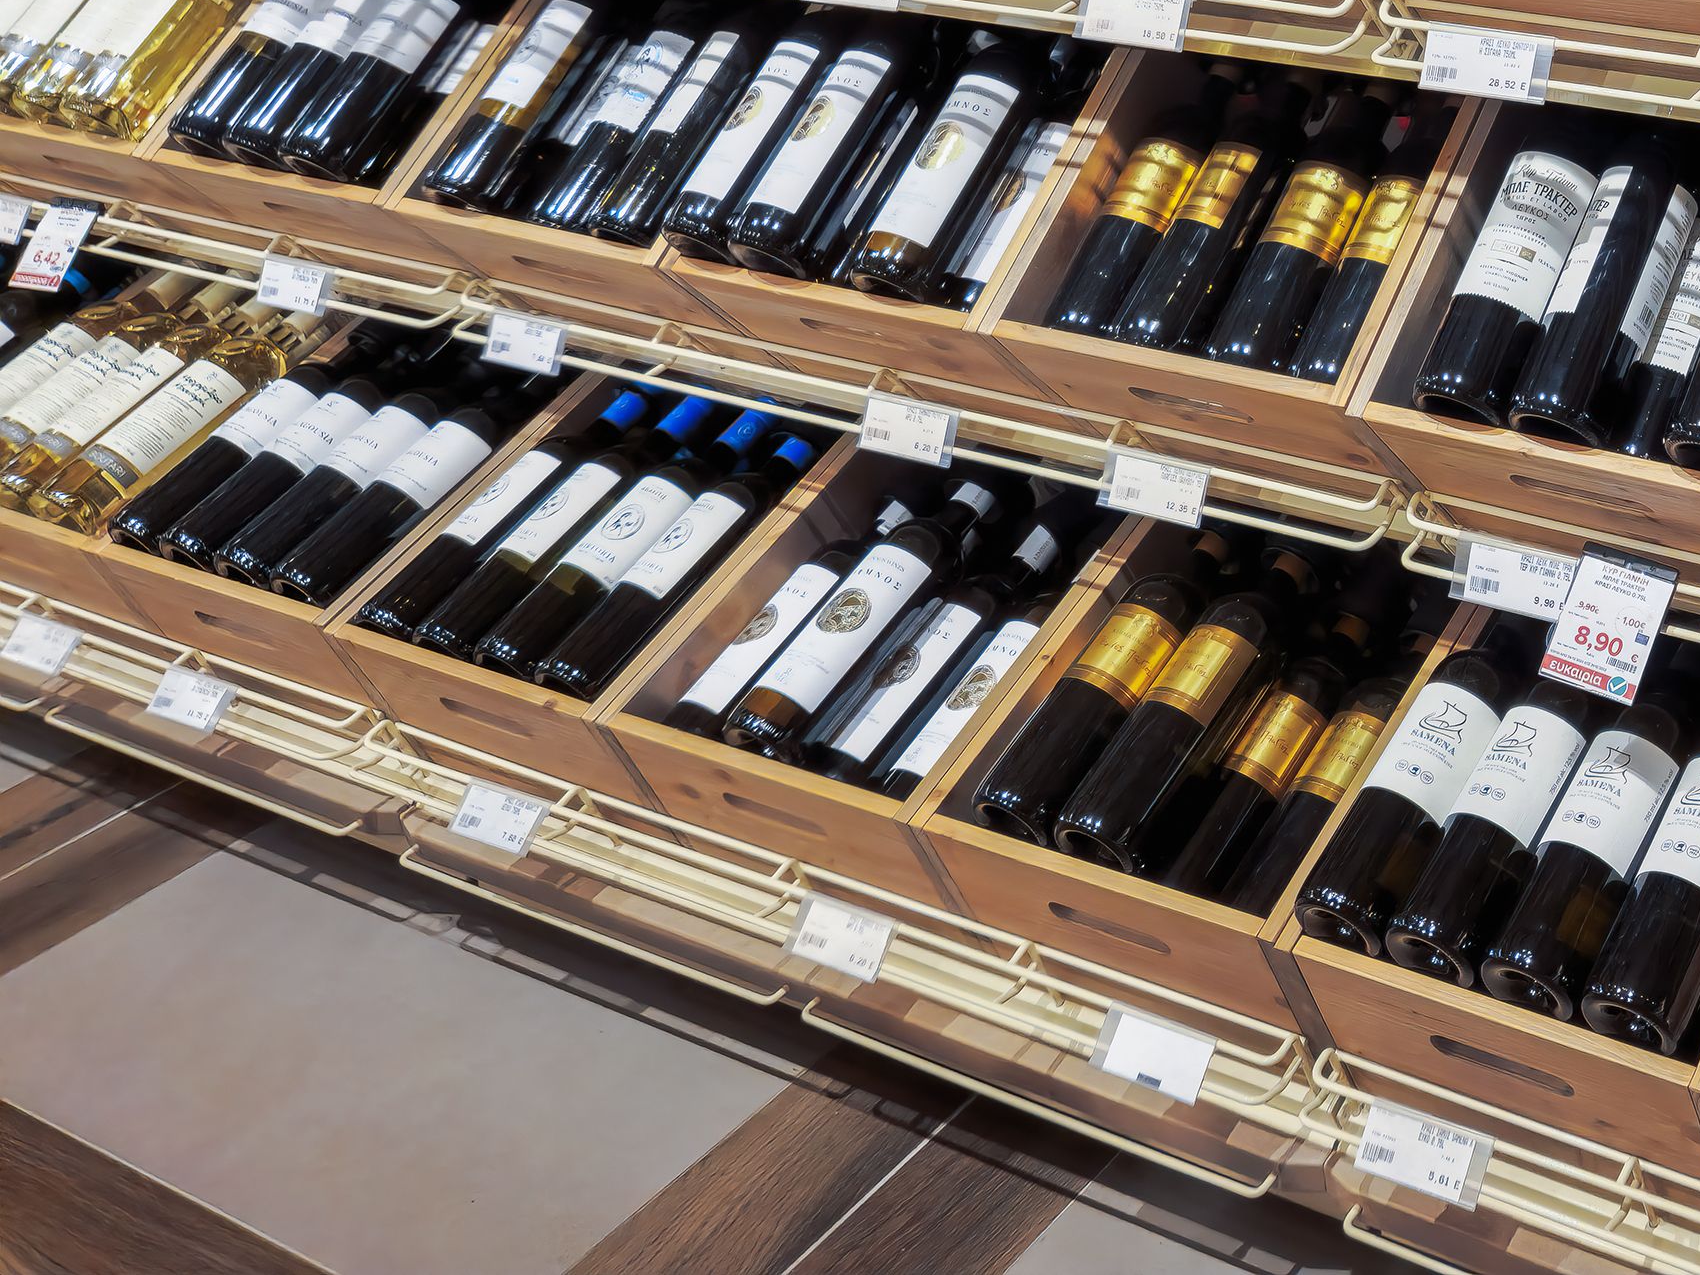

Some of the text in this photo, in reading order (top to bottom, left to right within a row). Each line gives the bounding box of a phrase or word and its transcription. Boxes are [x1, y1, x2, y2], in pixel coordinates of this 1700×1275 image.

[1488, 78, 1516, 90] 28,52
[1501, 180, 1578, 217] ΜΠΛΕ ΤΡΑΚΤΕΡ
[1512, 203, 1550, 222] ΛΕΥΚΟΣ
[1529, 564, 1539, 574] ΚΥΡ
[1602, 564, 1650, 586] ΚΥΡ ΓΙΑΝΝΗ
[1594, 580, 1611, 590] ΚΡΑΣΙ
[1602, 574, 1646, 593] ΜΠΛΕ ΤΡΑΚΤΕΡ
[1533, 596, 1555, 609] 9,90
[1574, 625, 1623, 657] 8,90
[1549, 660, 1602, 686] ευκαιρία
[1411, 728, 1456, 758] SAMENA
[1485, 753, 1527, 772] SAMENA
[1576, 779, 1622, 798] SAMENA
